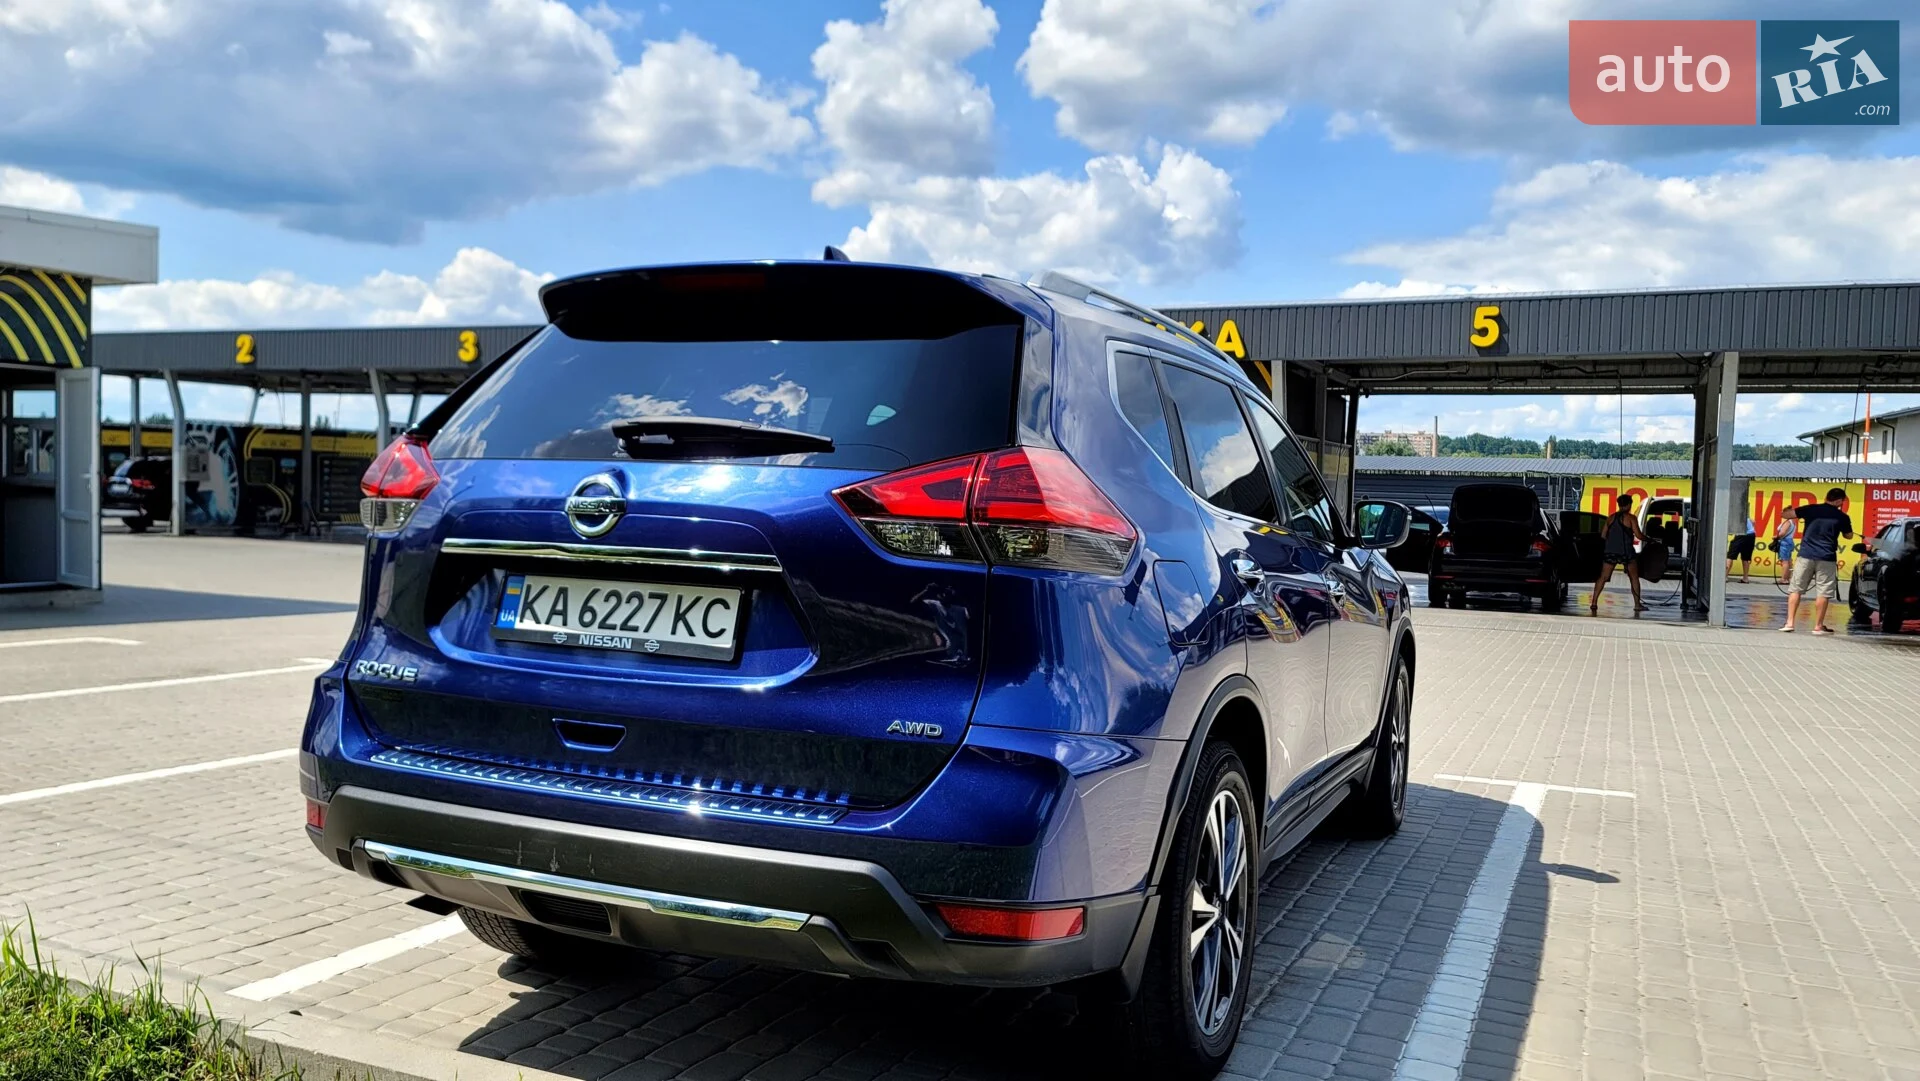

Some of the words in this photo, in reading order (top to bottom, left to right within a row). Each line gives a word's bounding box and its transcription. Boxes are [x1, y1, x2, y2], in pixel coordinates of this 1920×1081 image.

[1470, 306, 1500, 348] 5
[235, 333, 256, 364] 2
[457, 330, 479, 362] 3
[1872, 489, 1891, 501] ВСІ
[501, 609, 515, 622] UA
[519, 583, 569, 627] KA
[578, 587, 669, 632] 6227
[670, 594, 731, 639] KC
[578, 634, 633, 650] NISSAN
[355, 659, 418, 682] ROGUE
[886, 719, 943, 737] AWD
